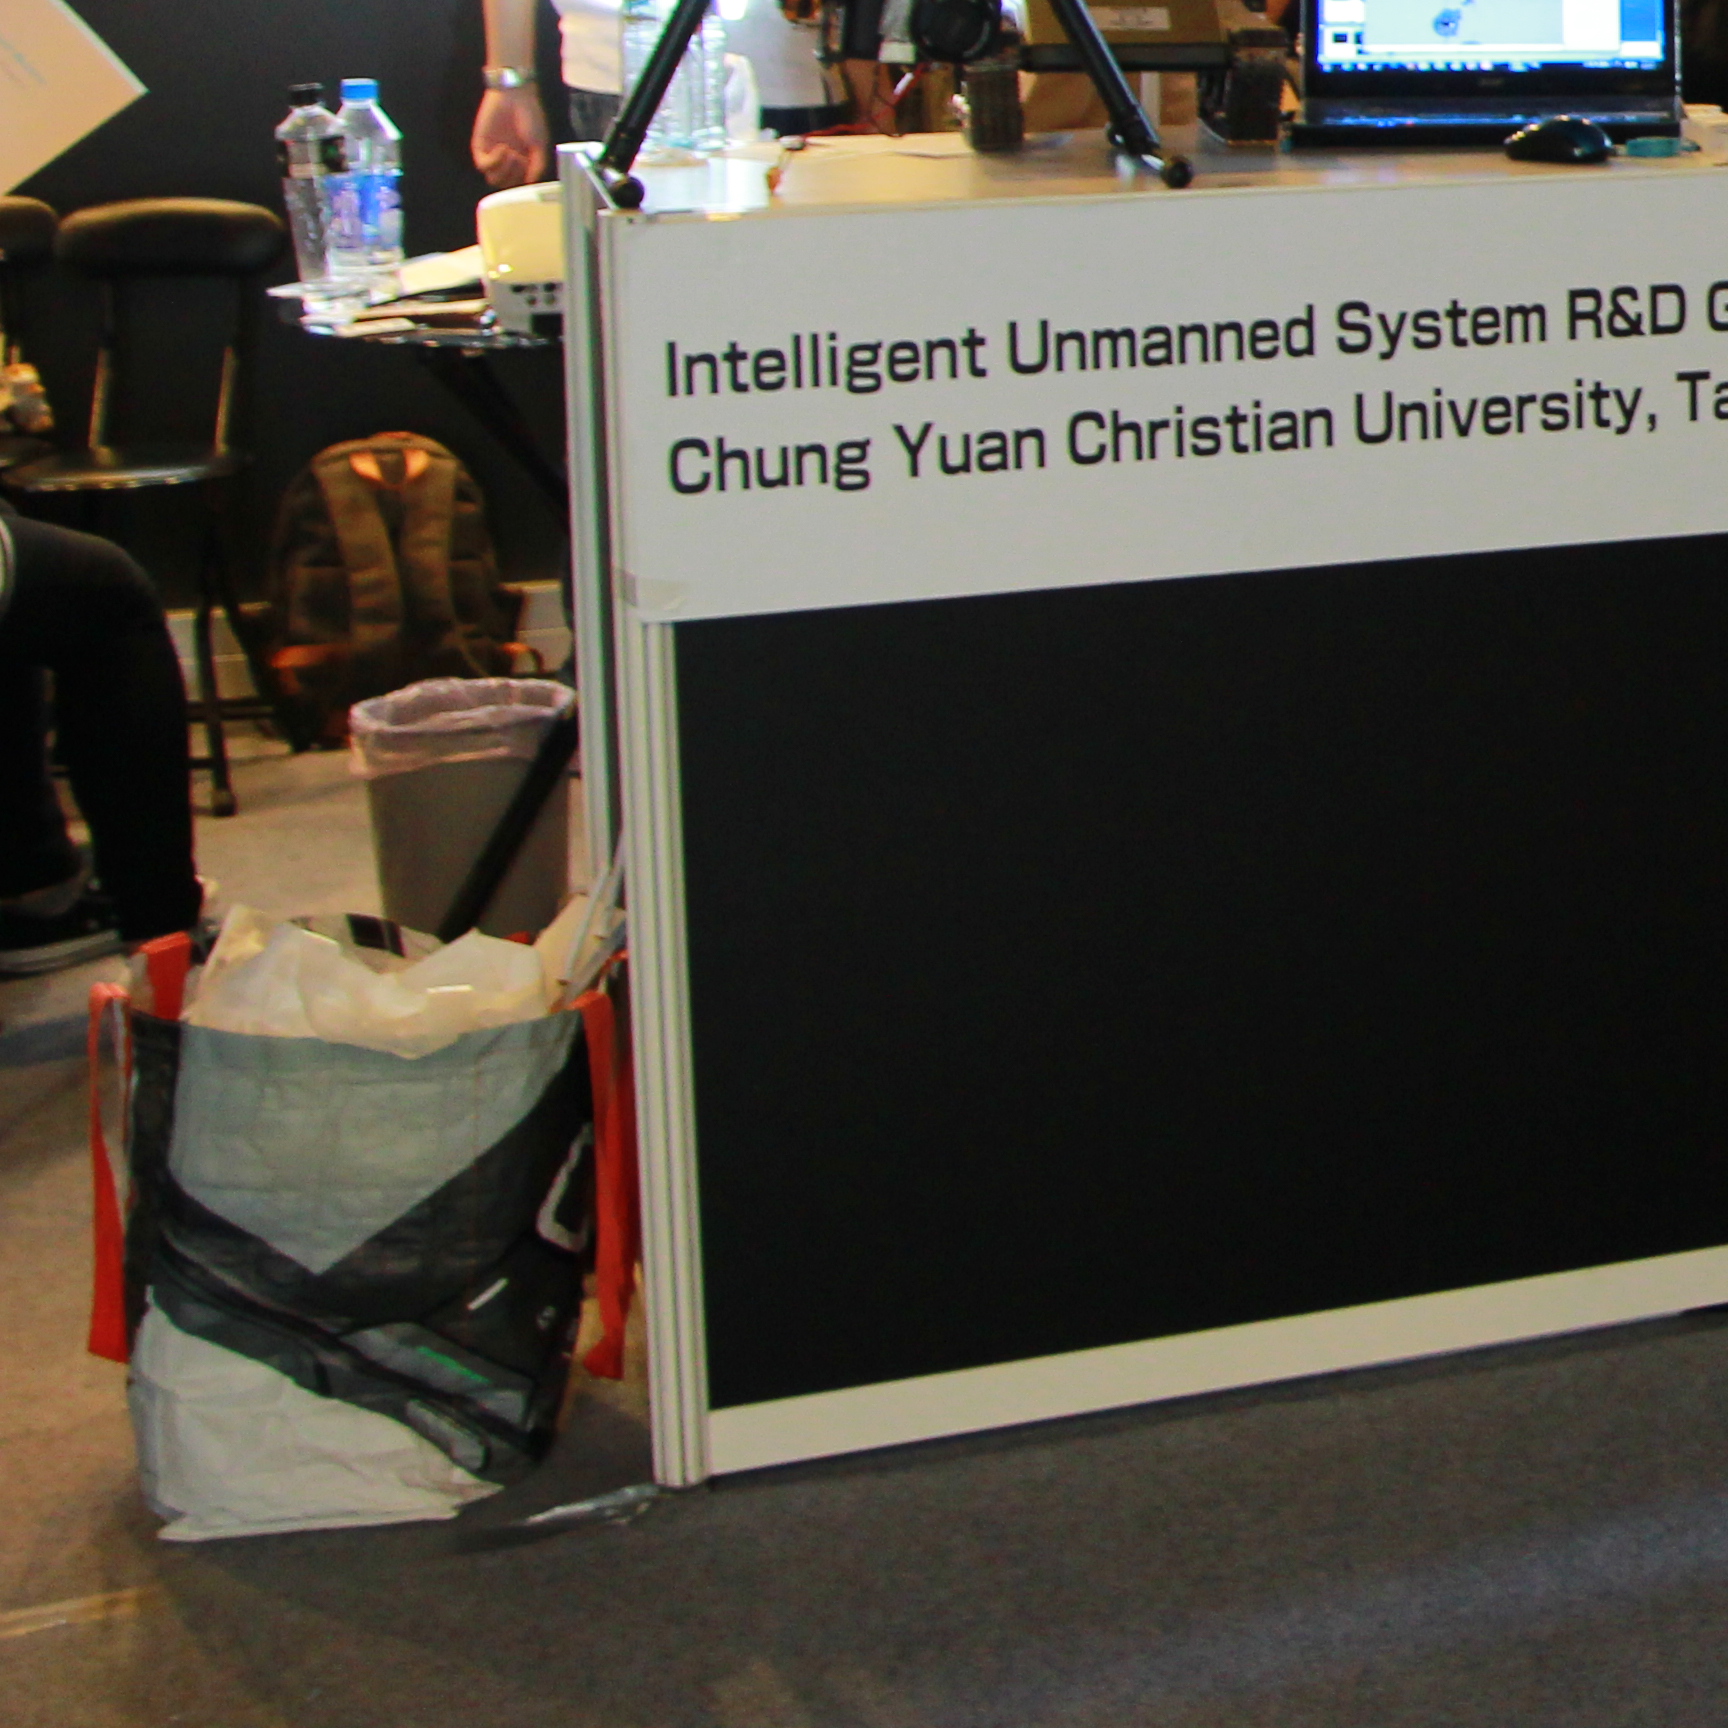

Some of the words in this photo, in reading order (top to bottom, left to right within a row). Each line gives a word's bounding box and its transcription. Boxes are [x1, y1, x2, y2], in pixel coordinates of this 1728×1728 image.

[666, 333, 987, 393] Intelligent
[1008, 311, 1314, 371] Unmanned
[1336, 302, 1546, 356] System
[1568, 285, 1686, 337] R&D
[669, 439, 870, 492] Chung
[894, 425, 1045, 474] Yuan
[1067, 406, 1333, 462] Christian
[1355, 383, 1656, 441] University,
